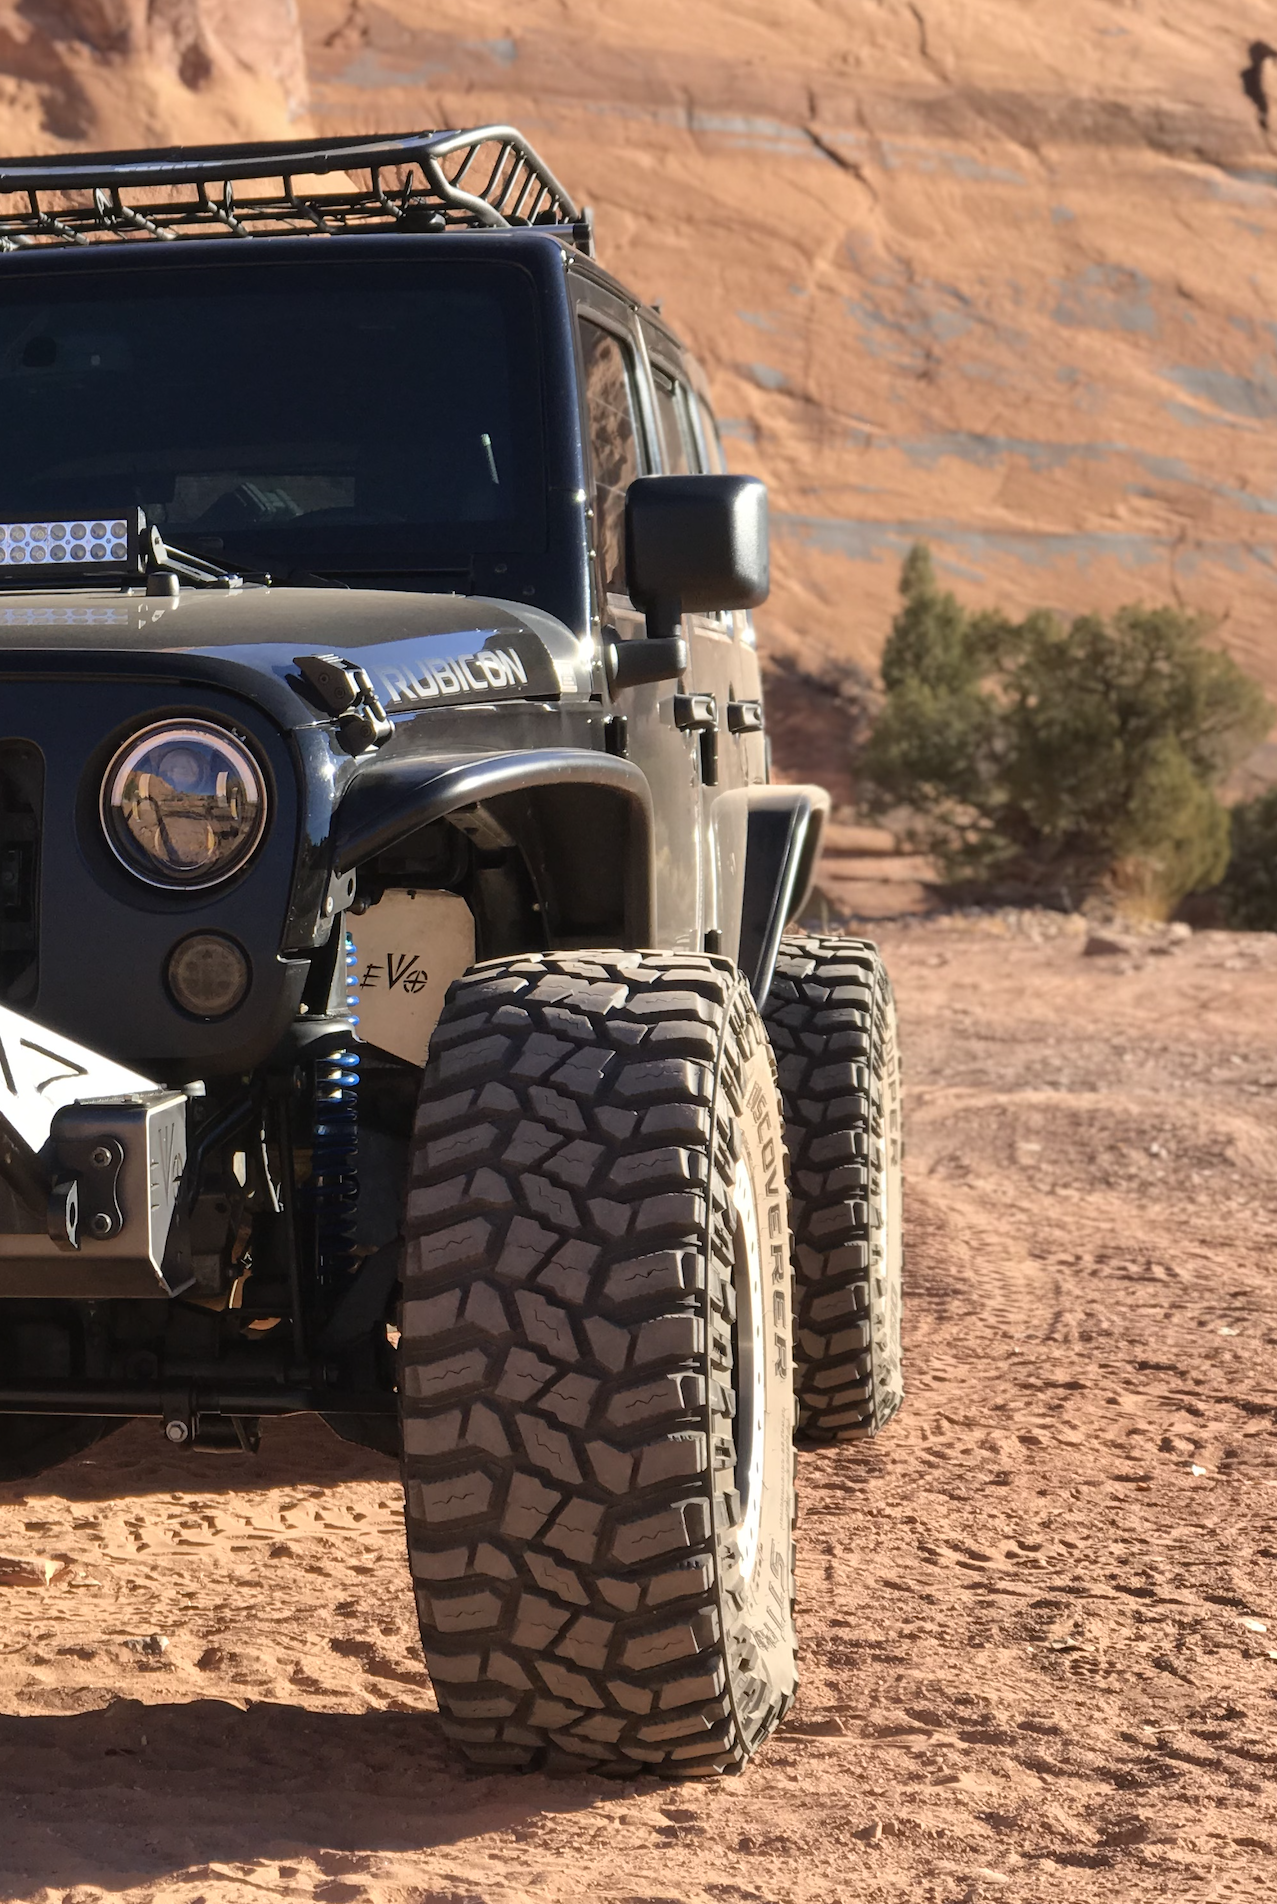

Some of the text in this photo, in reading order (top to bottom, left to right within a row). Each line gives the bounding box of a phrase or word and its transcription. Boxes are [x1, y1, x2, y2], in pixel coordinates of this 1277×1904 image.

[374, 647, 529, 704] RUBICON
[359, 953, 429, 994] EVO
[745, 1079, 789, 1382] DISCOVERER
